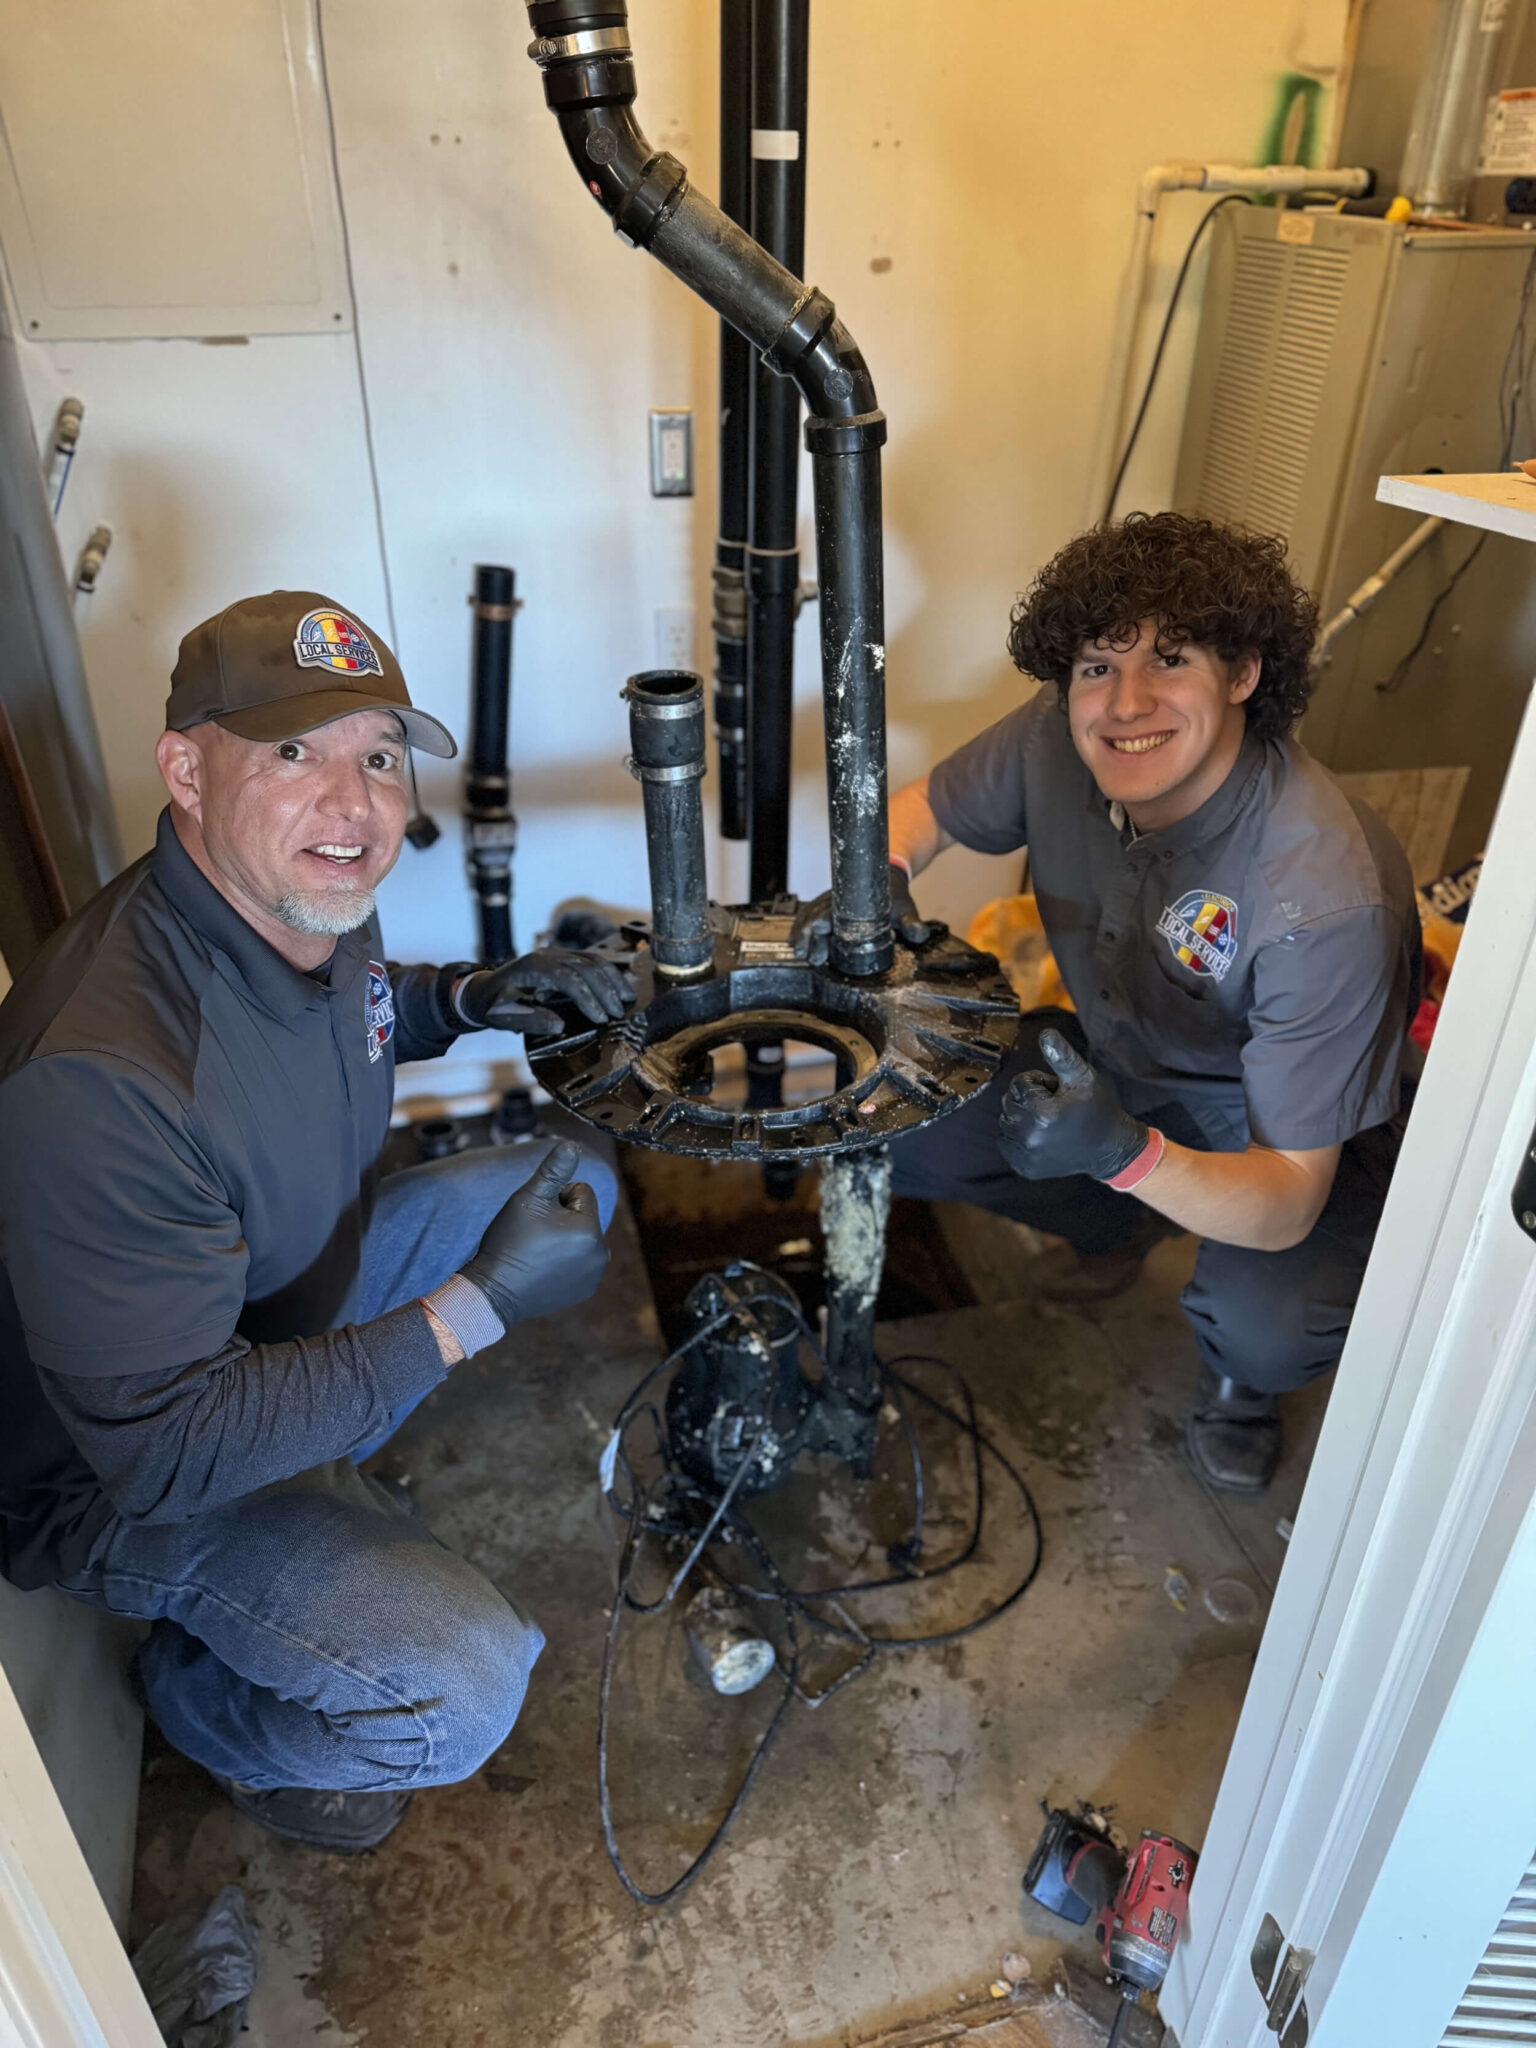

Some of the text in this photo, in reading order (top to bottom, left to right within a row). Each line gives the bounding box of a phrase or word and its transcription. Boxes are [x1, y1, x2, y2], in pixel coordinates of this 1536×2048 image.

[299, 643, 379, 667] LOCAL SERVICES
[1158, 908, 1189, 944] LOCAL
